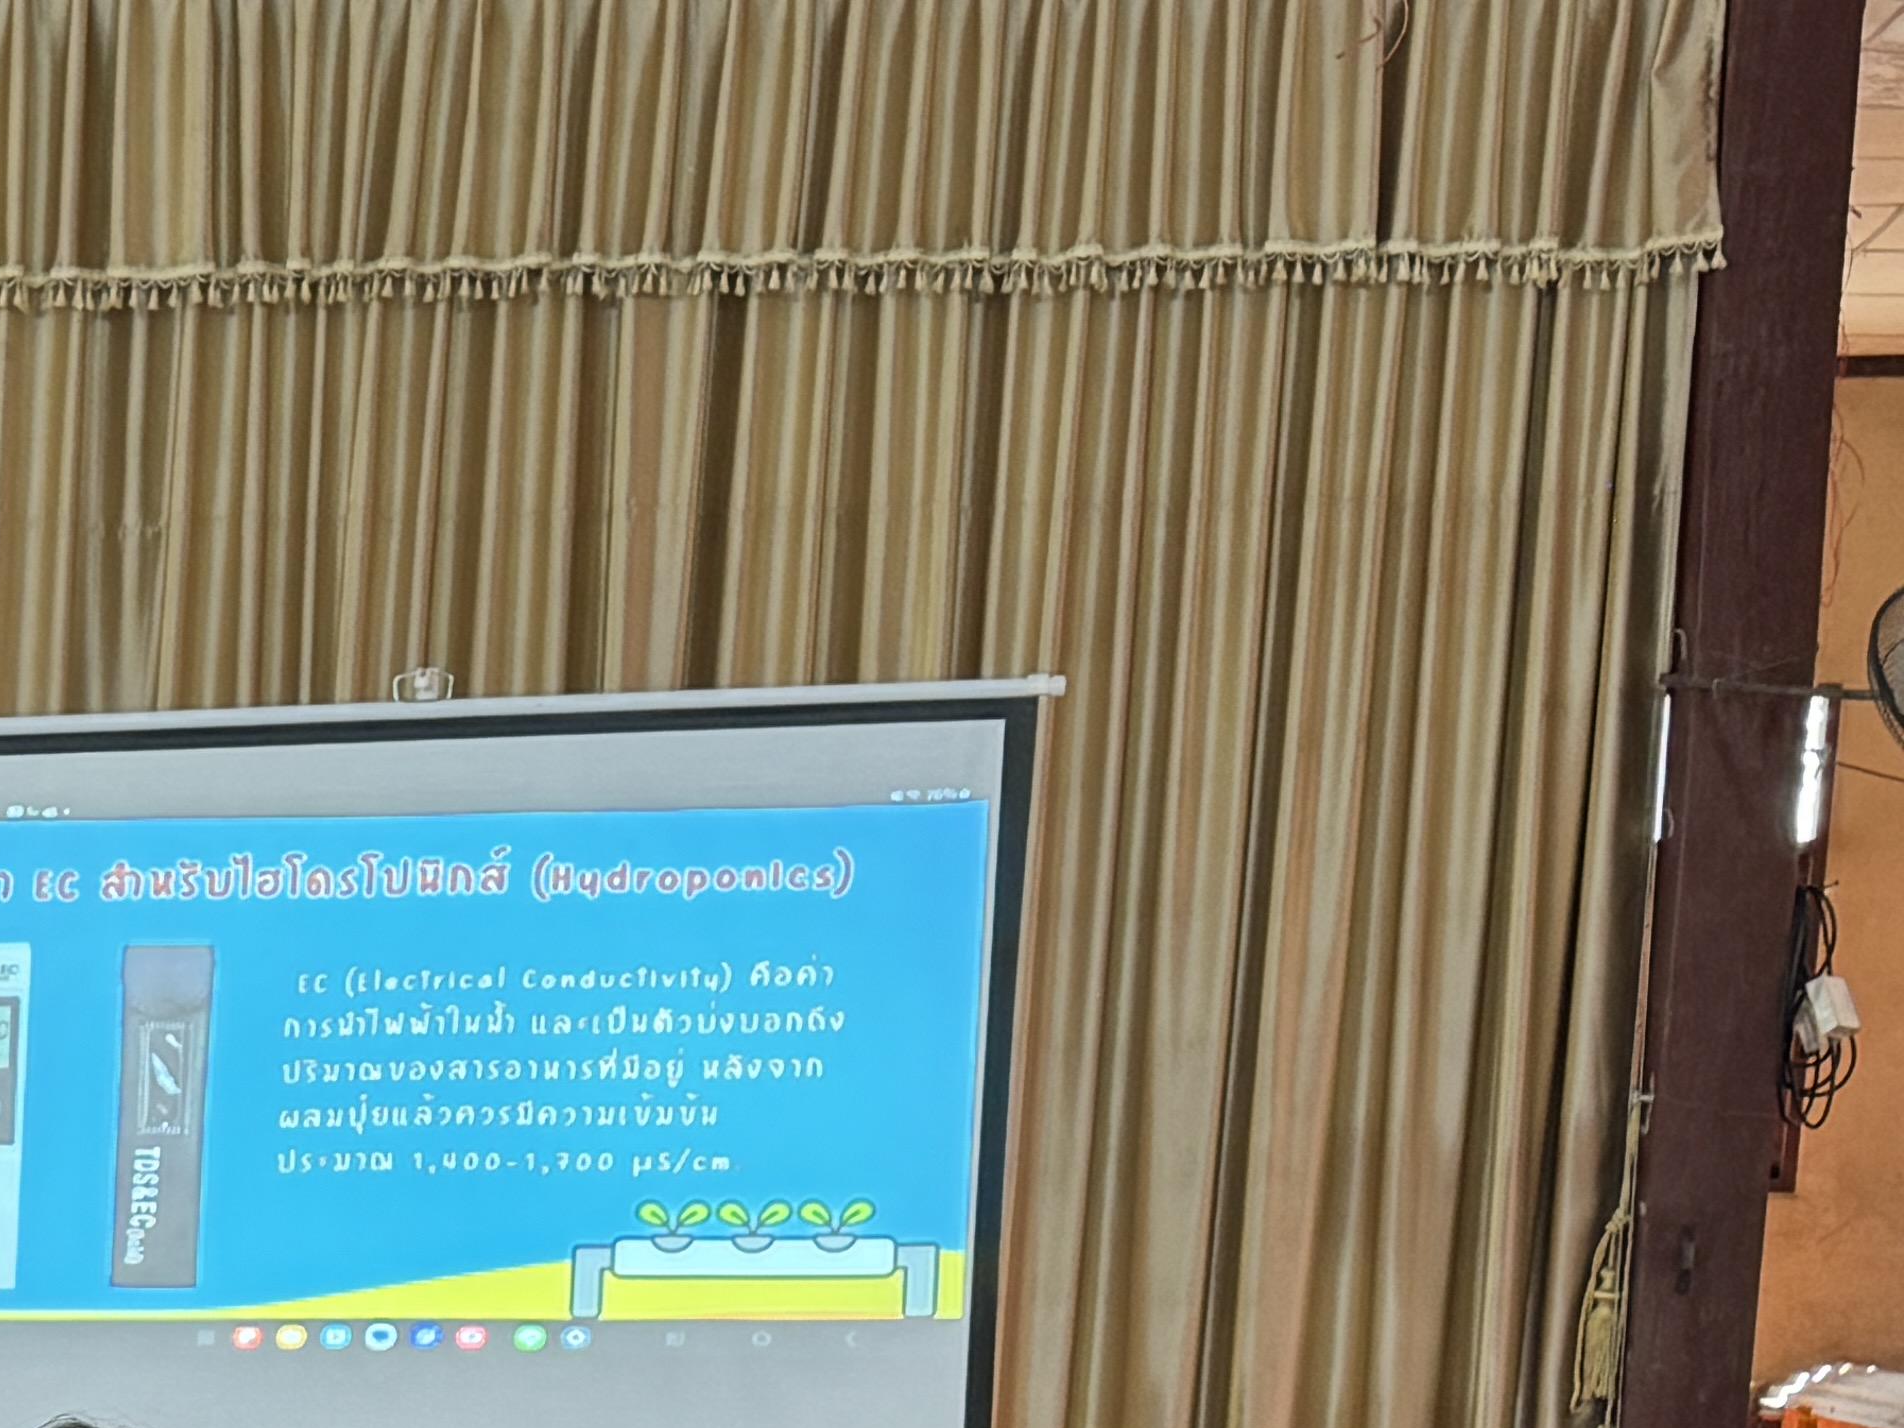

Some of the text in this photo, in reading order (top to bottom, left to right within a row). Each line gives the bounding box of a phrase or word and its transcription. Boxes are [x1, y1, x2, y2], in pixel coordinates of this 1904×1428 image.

[32, 869, 81, 903] EC
[99, 846, 512, 903] สำหรับไฮโดรโปนิกส์
[531, 846, 855, 902] (Hydroponics)
[298, 973, 329, 994] EC
[522, 960, 733, 993] Conductivity)
[750, 953, 835, 988] คือค่า
[702, 1053, 825, 1081] หลังจาก
[277, 1149, 394, 1176] ประมาณ
